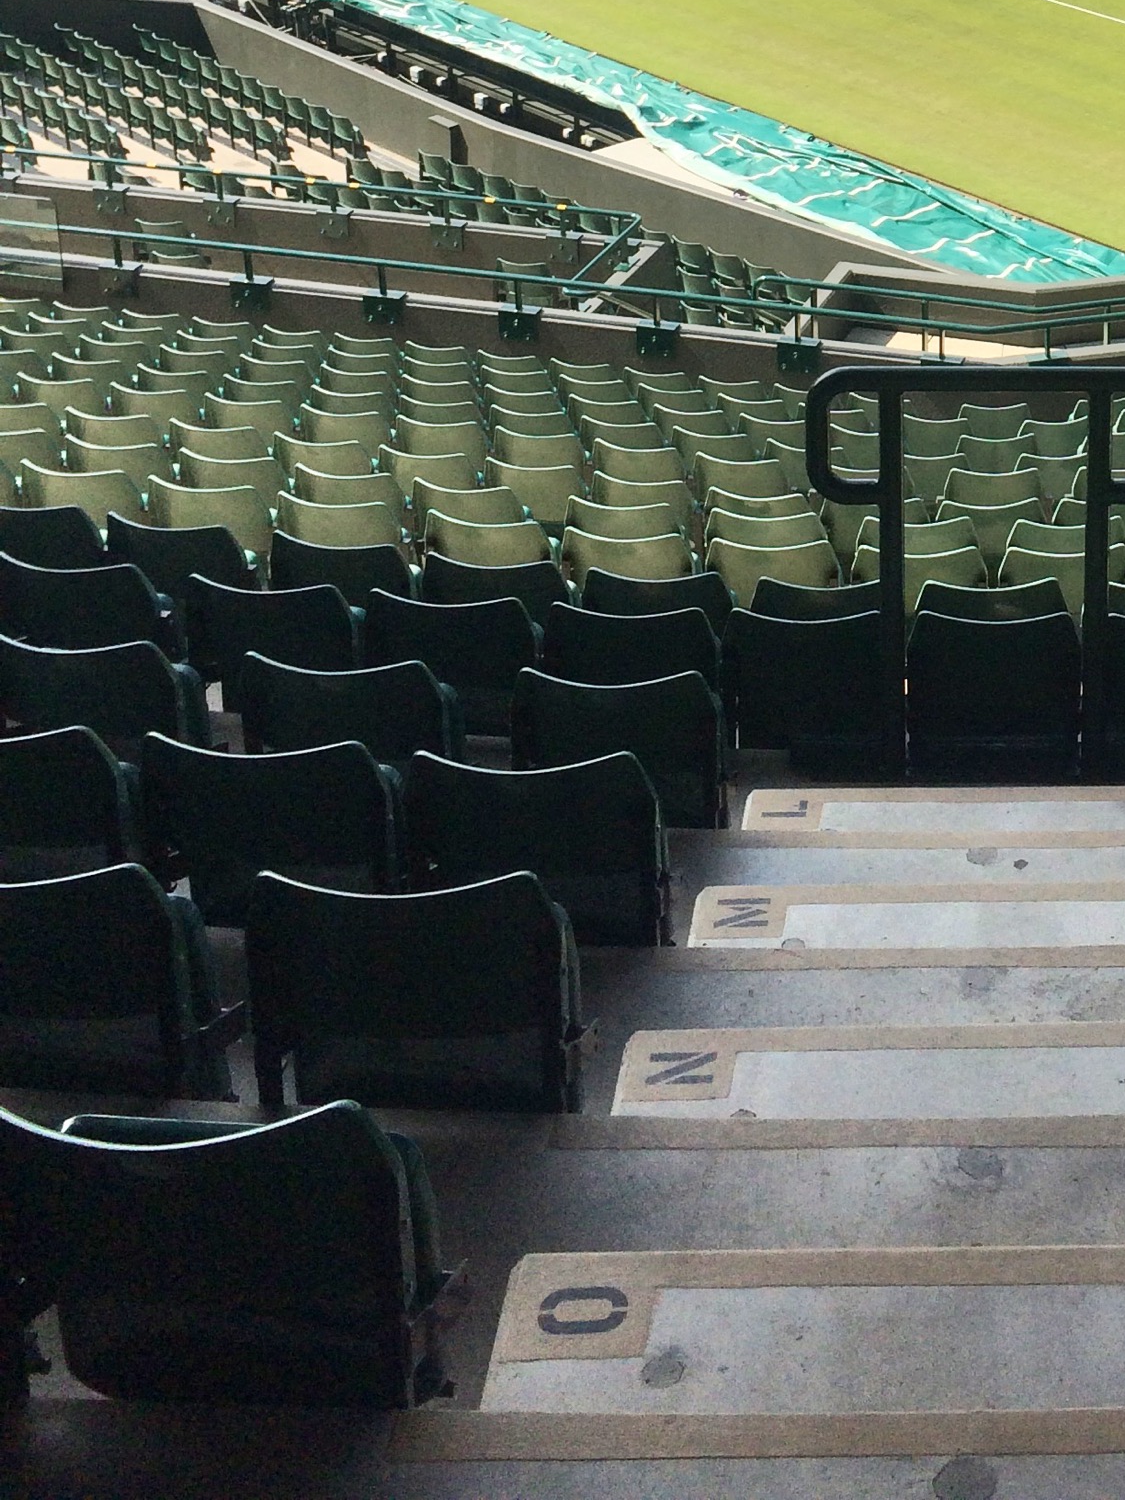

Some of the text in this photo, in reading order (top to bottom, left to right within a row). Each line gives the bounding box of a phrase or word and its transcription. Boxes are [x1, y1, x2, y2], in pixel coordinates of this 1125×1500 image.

[713, 897, 772, 929] M
[645, 1051, 718, 1085] N
[537, 1286, 629, 1335] O
